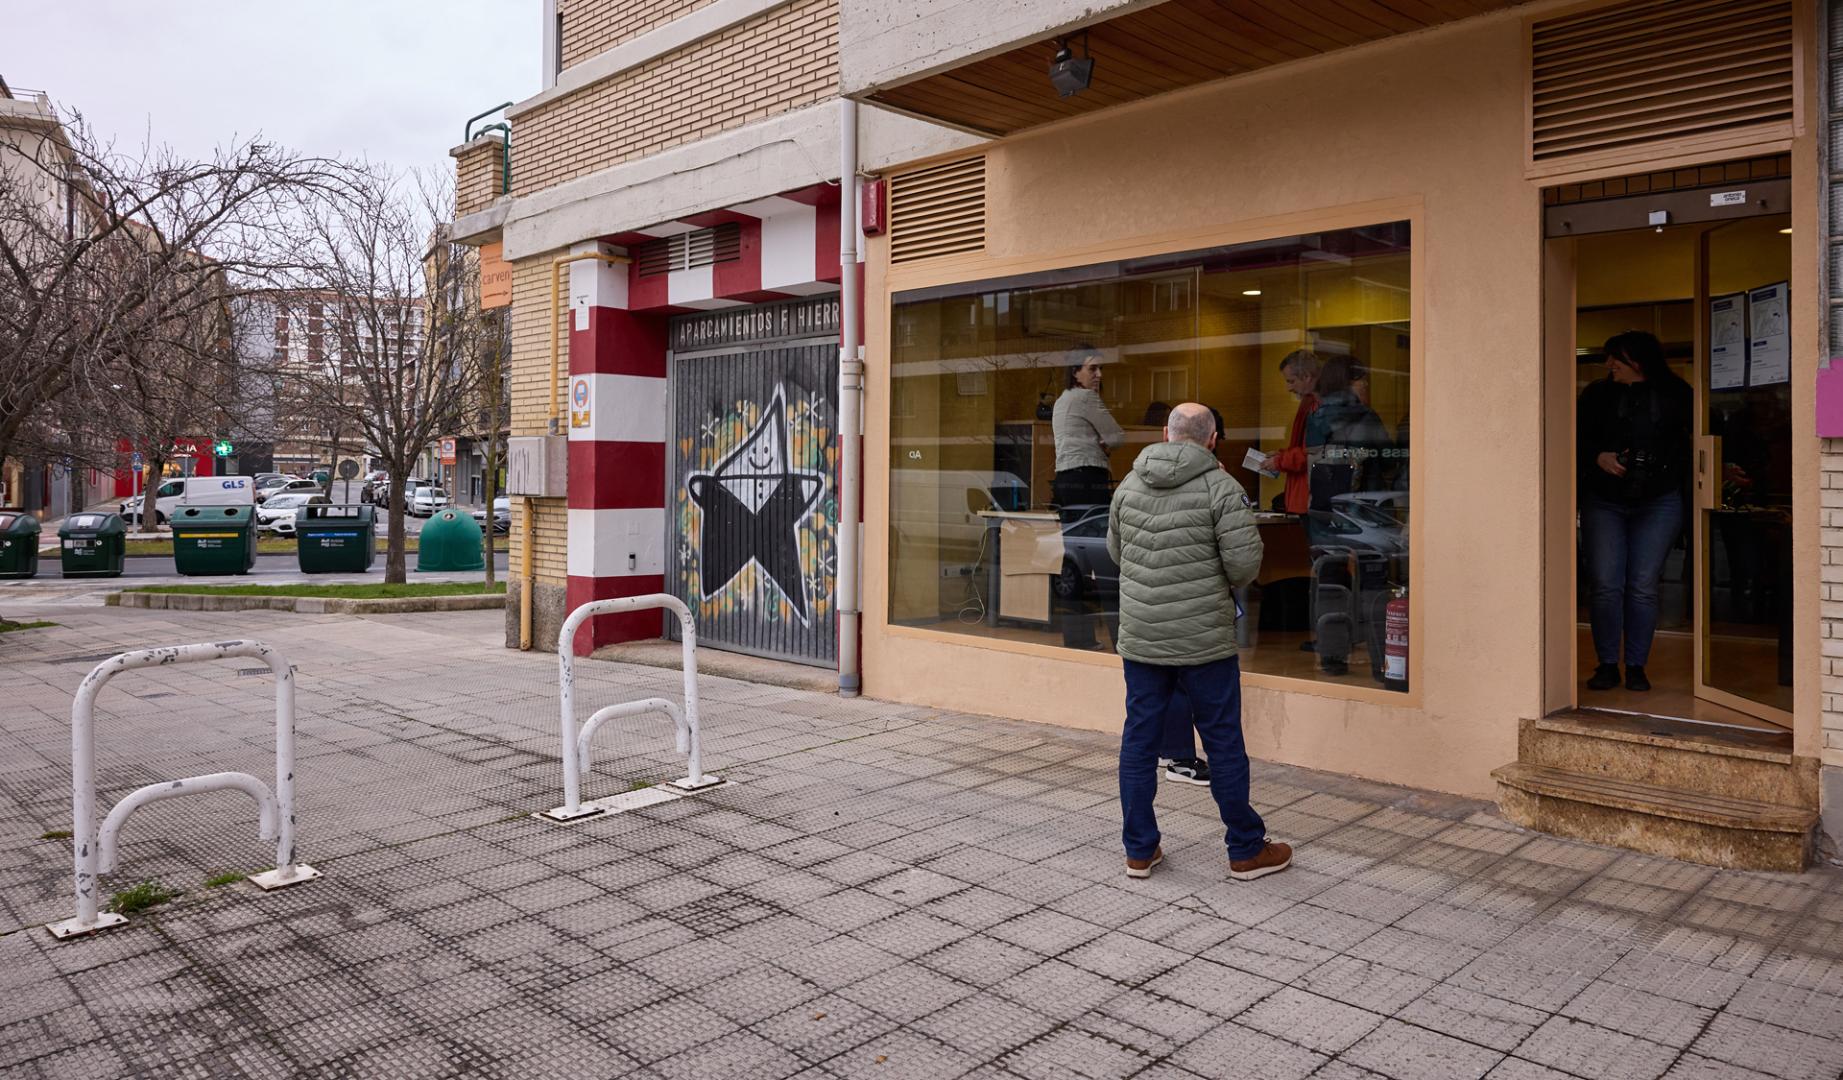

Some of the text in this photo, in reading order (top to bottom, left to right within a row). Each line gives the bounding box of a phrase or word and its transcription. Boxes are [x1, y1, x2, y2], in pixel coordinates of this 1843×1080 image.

[482, 270, 510, 285] carven
[679, 312, 773, 343] APARCAMIENTOS
[222, 480, 245, 489] GLS
